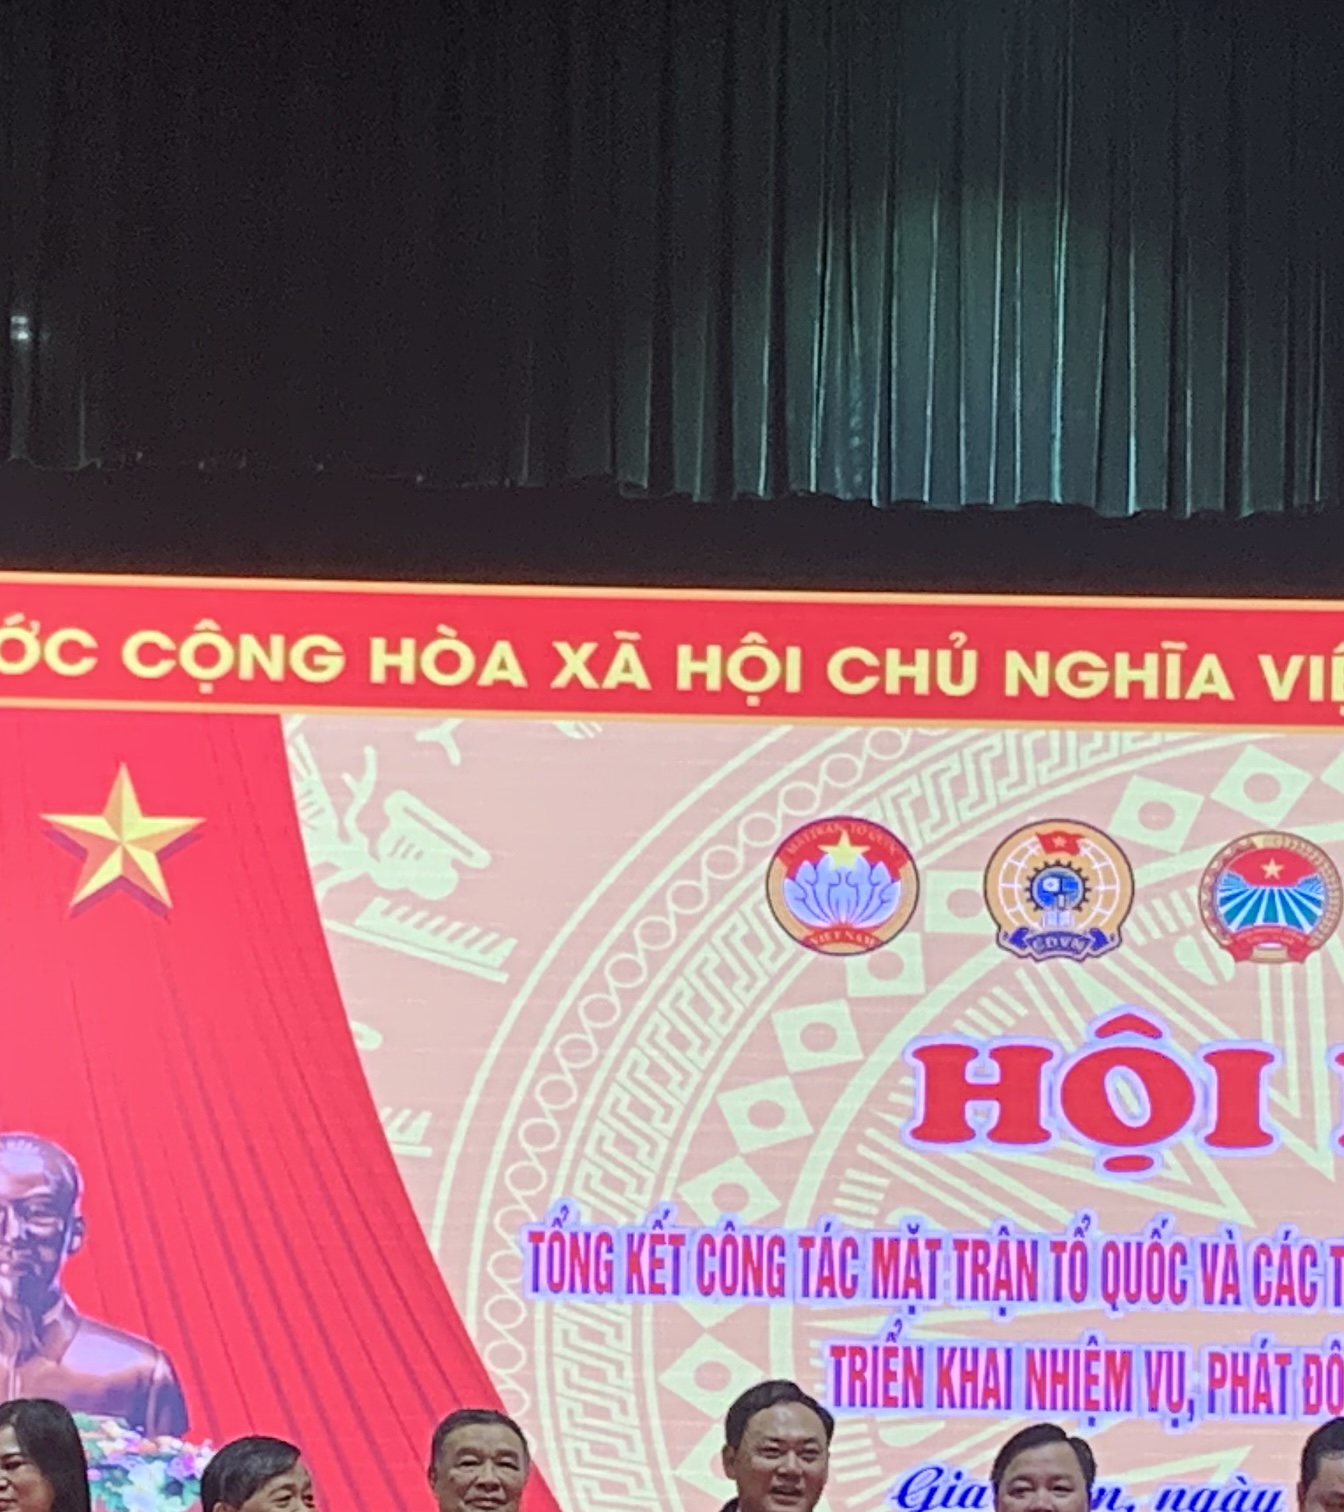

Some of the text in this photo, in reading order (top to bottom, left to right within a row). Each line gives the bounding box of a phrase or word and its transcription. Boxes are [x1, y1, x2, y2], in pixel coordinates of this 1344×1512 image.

[123, 620, 345, 694] CỘNG
[370, 625, 528, 687] HÒA
[551, 630, 653, 690] XÃ
[676, 632, 802, 705] HỘI
[827, 632, 981, 697] CHỦ
[1005, 640, 1234, 700] NGHĨA
[911, 1013, 1277, 1174] HỘI
[528, 1206, 613, 1295] TỔNG
[626, 1207, 686, 1296] KẾT
[696, 1220, 786, 1299] CÔNG
[798, 1222, 858, 1299] TÁC
[871, 1223, 943, 1316] MẶT
[953, 1225, 1039, 1317] TRẬN
[1050, 1214, 1091, 1305] TỔ
[1101, 1218, 1187, 1313] QUỐC
[1200, 1229, 1241, 1306] VÀ
[1256, 1229, 1318, 1308] CÁC
[829, 1318, 925, 1409] TRIỂN
[937, 1346, 1013, 1410] KHAI
[1026, 1335, 1133, 1427] NHIỆM
[1145, 1350, 1195, 1428] VỤ,
[1208, 1339, 1293, 1416] PHÁT
